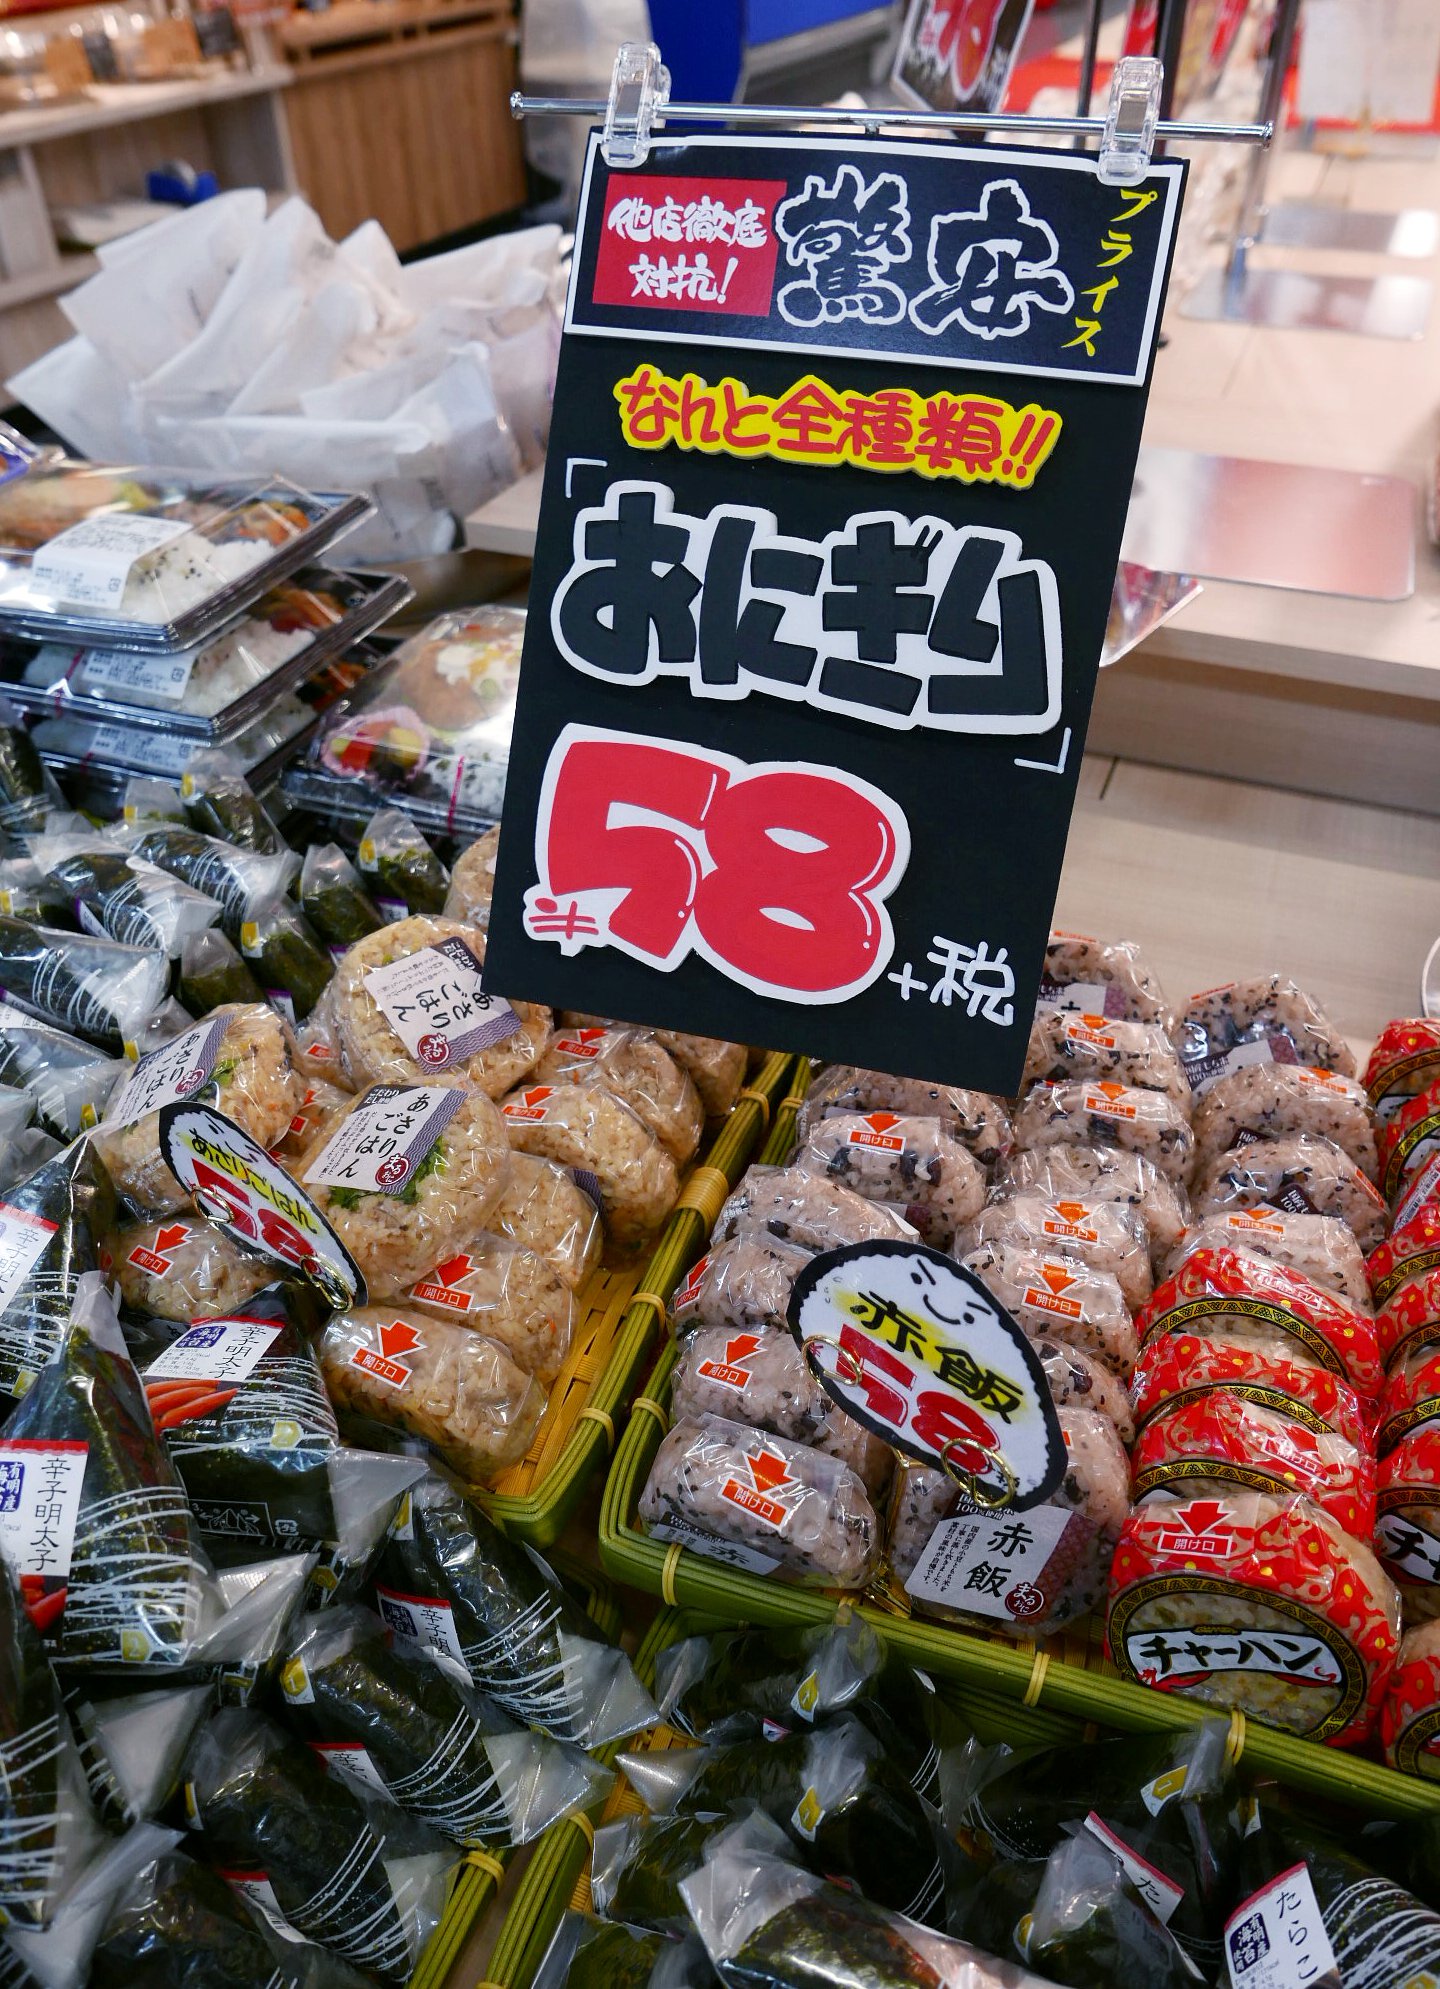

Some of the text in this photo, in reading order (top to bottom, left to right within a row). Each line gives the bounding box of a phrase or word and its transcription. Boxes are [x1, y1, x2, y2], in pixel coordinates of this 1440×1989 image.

[608, 195, 768, 248] 他店徹底
[775, 164, 1075, 341] 驚安
[1060, 188, 1158, 357] プライス
[337, 1111, 402, 1179] ごはん
[378, 1092, 431, 1159] あさり
[423, 1285, 461, 1307] 開け口
[208, 1325, 267, 1379] 辛子明太子
[361, 1353, 399, 1379] 開け口
[849, 1289, 1025, 1425] 赤飯
[27, 1457, 72, 1572] 辛子明太子
[733, 1486, 775, 1518] 開け口
[962, 1522, 1035, 1599] 赤飯
[1173, 1537, 1216, 1552] 開け口
[1139, 1634, 1323, 1675] チャーハン
[1276, 1891, 1319, 1980] たらこ
